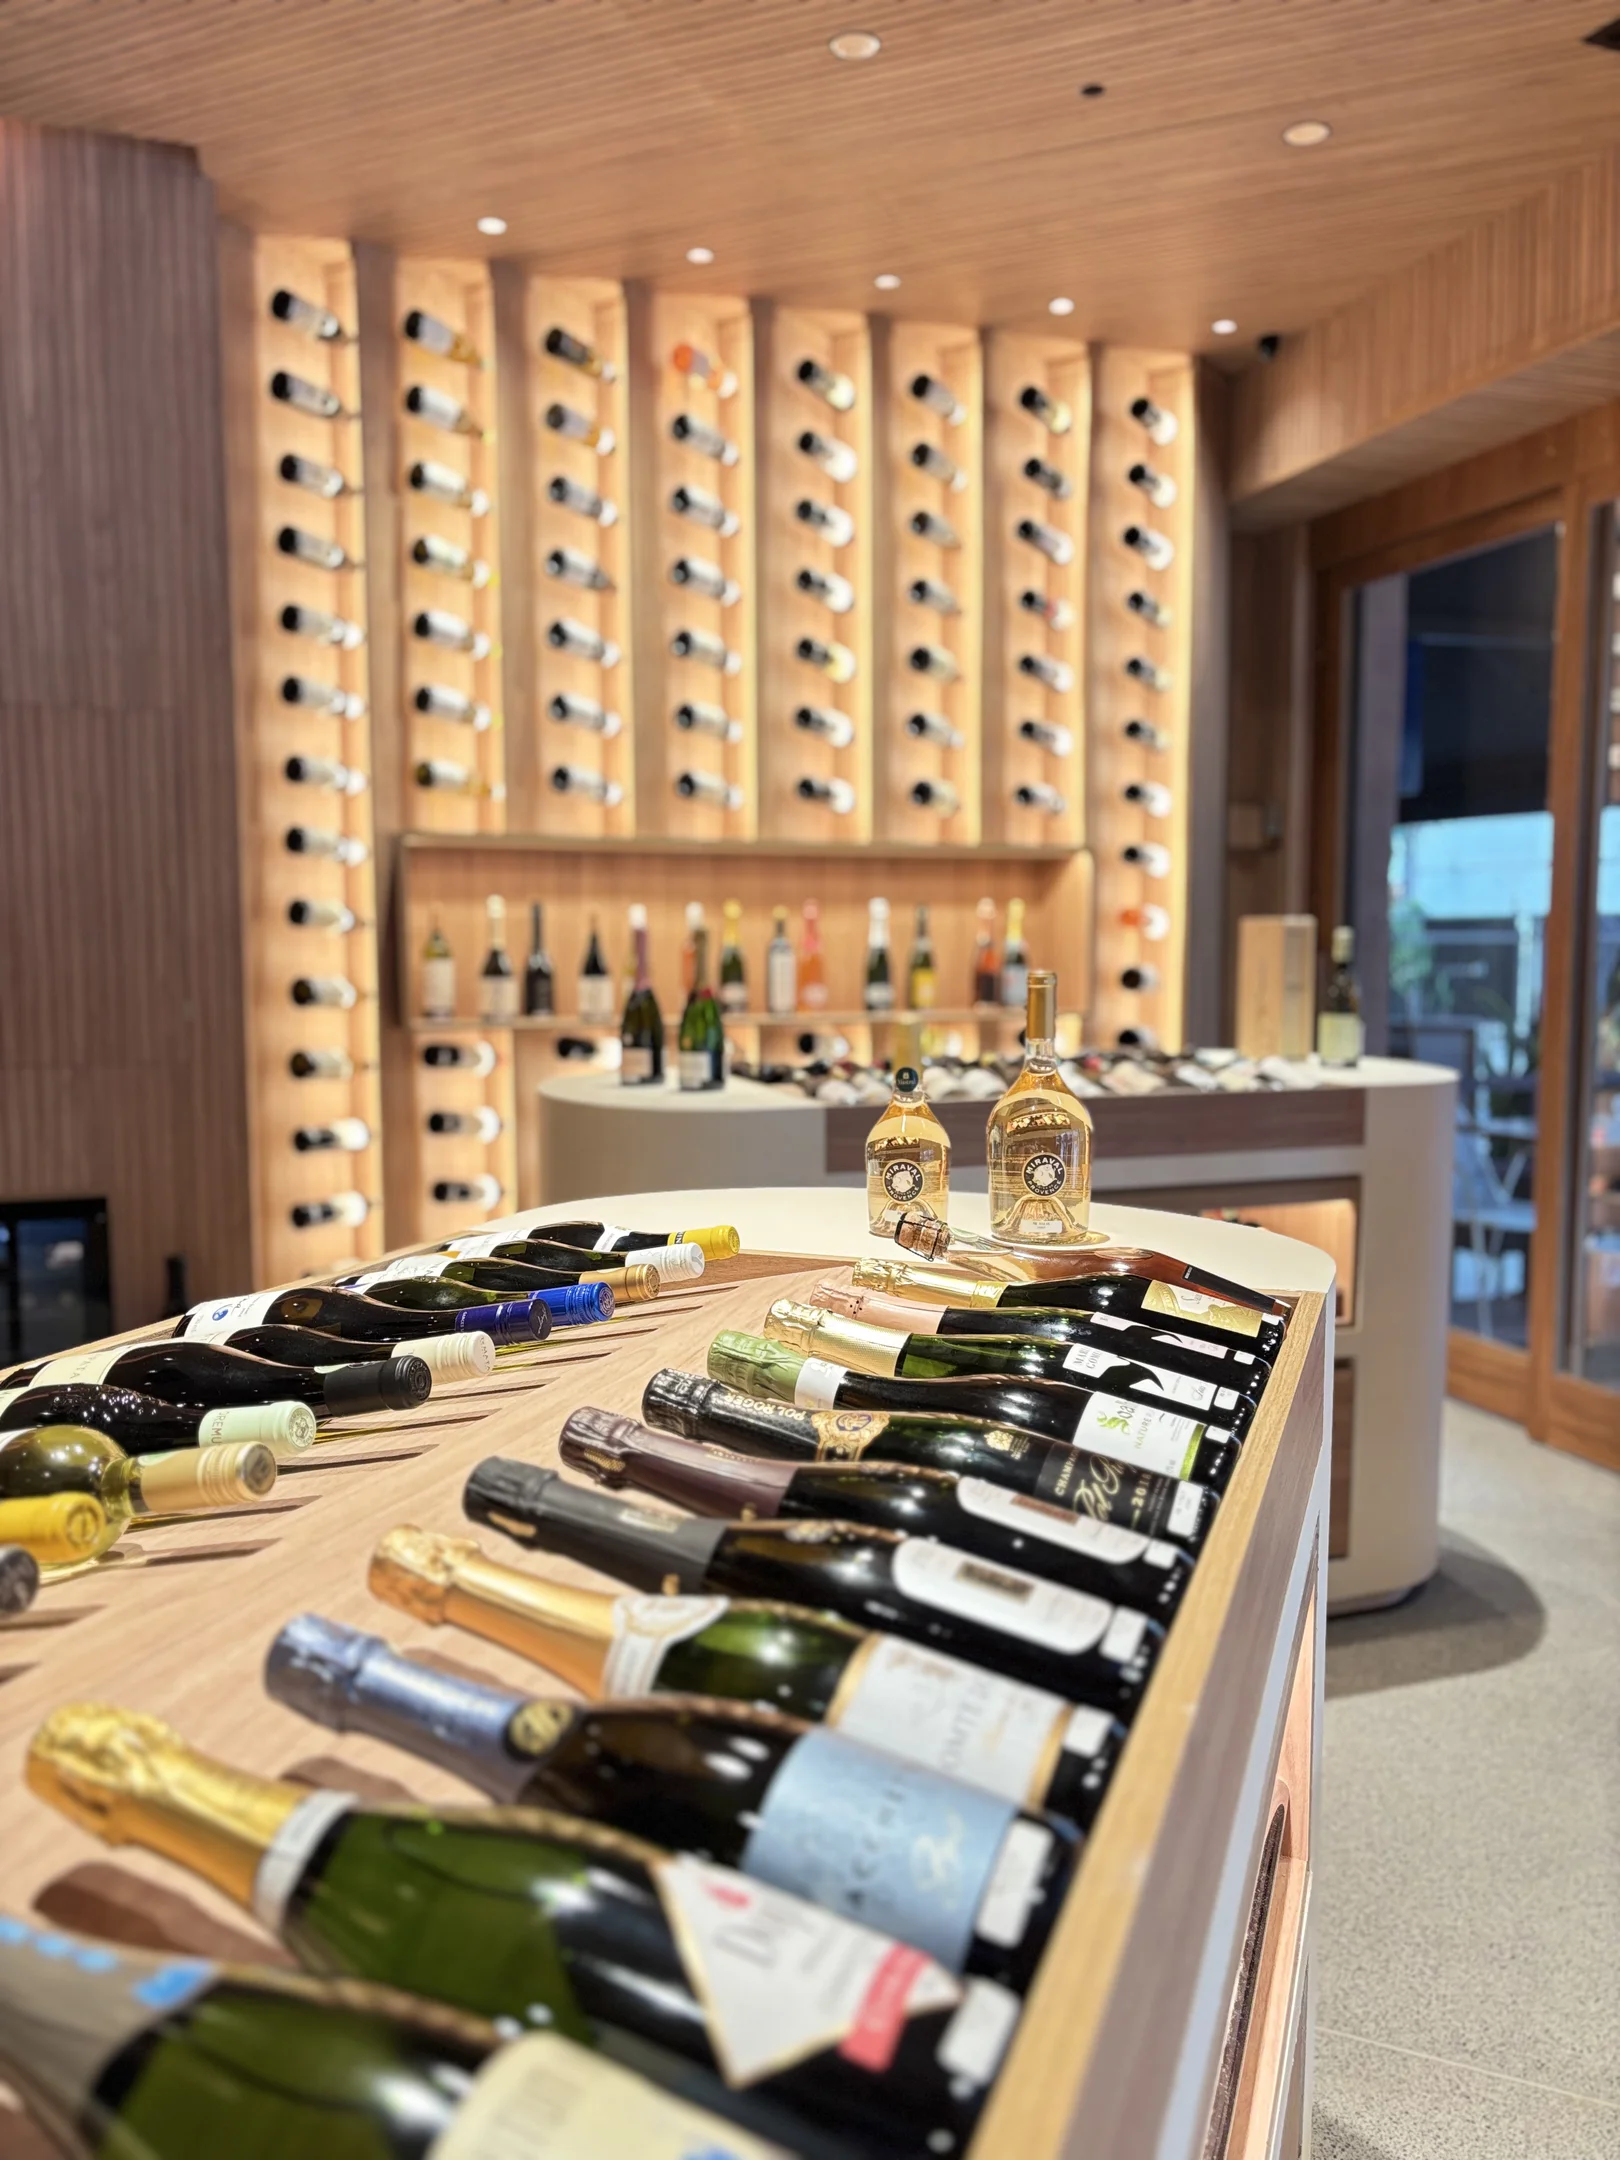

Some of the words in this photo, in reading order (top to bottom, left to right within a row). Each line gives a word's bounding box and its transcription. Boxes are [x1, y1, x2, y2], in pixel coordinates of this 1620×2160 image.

[886, 1164, 921, 1181] MIRAVAL
[1026, 1157, 1063, 1175] MIRAVAL
[887, 1186, 919, 1201] PROVENCE
[1028, 1180, 1062, 1195] PROVENCE
[723, 1393, 775, 1415] ROGER
[776, 1406, 806, 1420] POL
[211, 1411, 230, 1446] OREMU
[1134, 1415, 1152, 1450] NATURE
